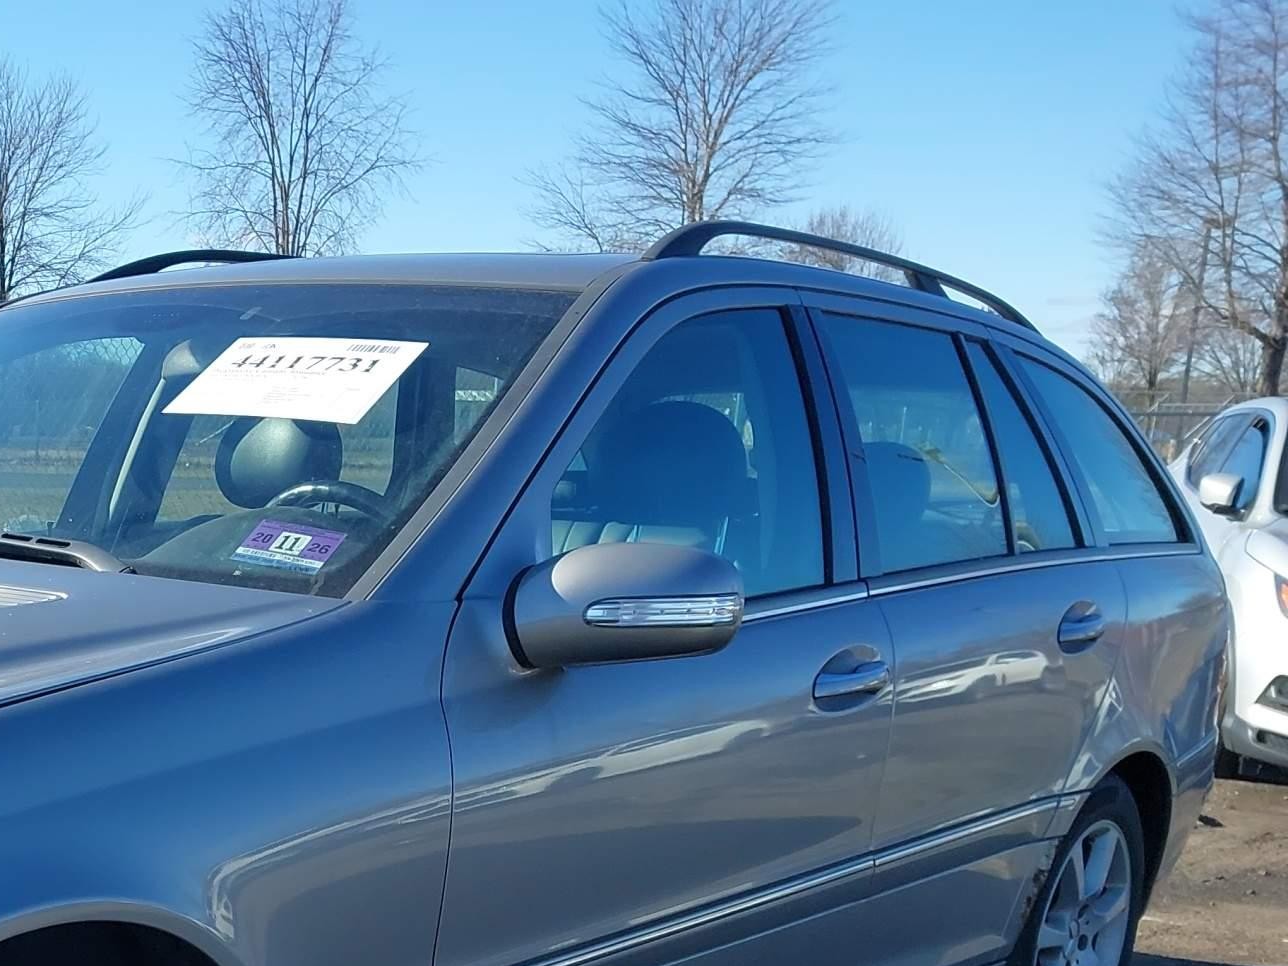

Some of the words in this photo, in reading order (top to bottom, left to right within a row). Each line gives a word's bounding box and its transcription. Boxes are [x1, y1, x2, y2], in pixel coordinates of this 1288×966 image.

[231, 354, 380, 373] 44117731
[252, 532, 274, 544] 20
[274, 534, 301, 552] 11
[307, 542, 331, 555] 26
